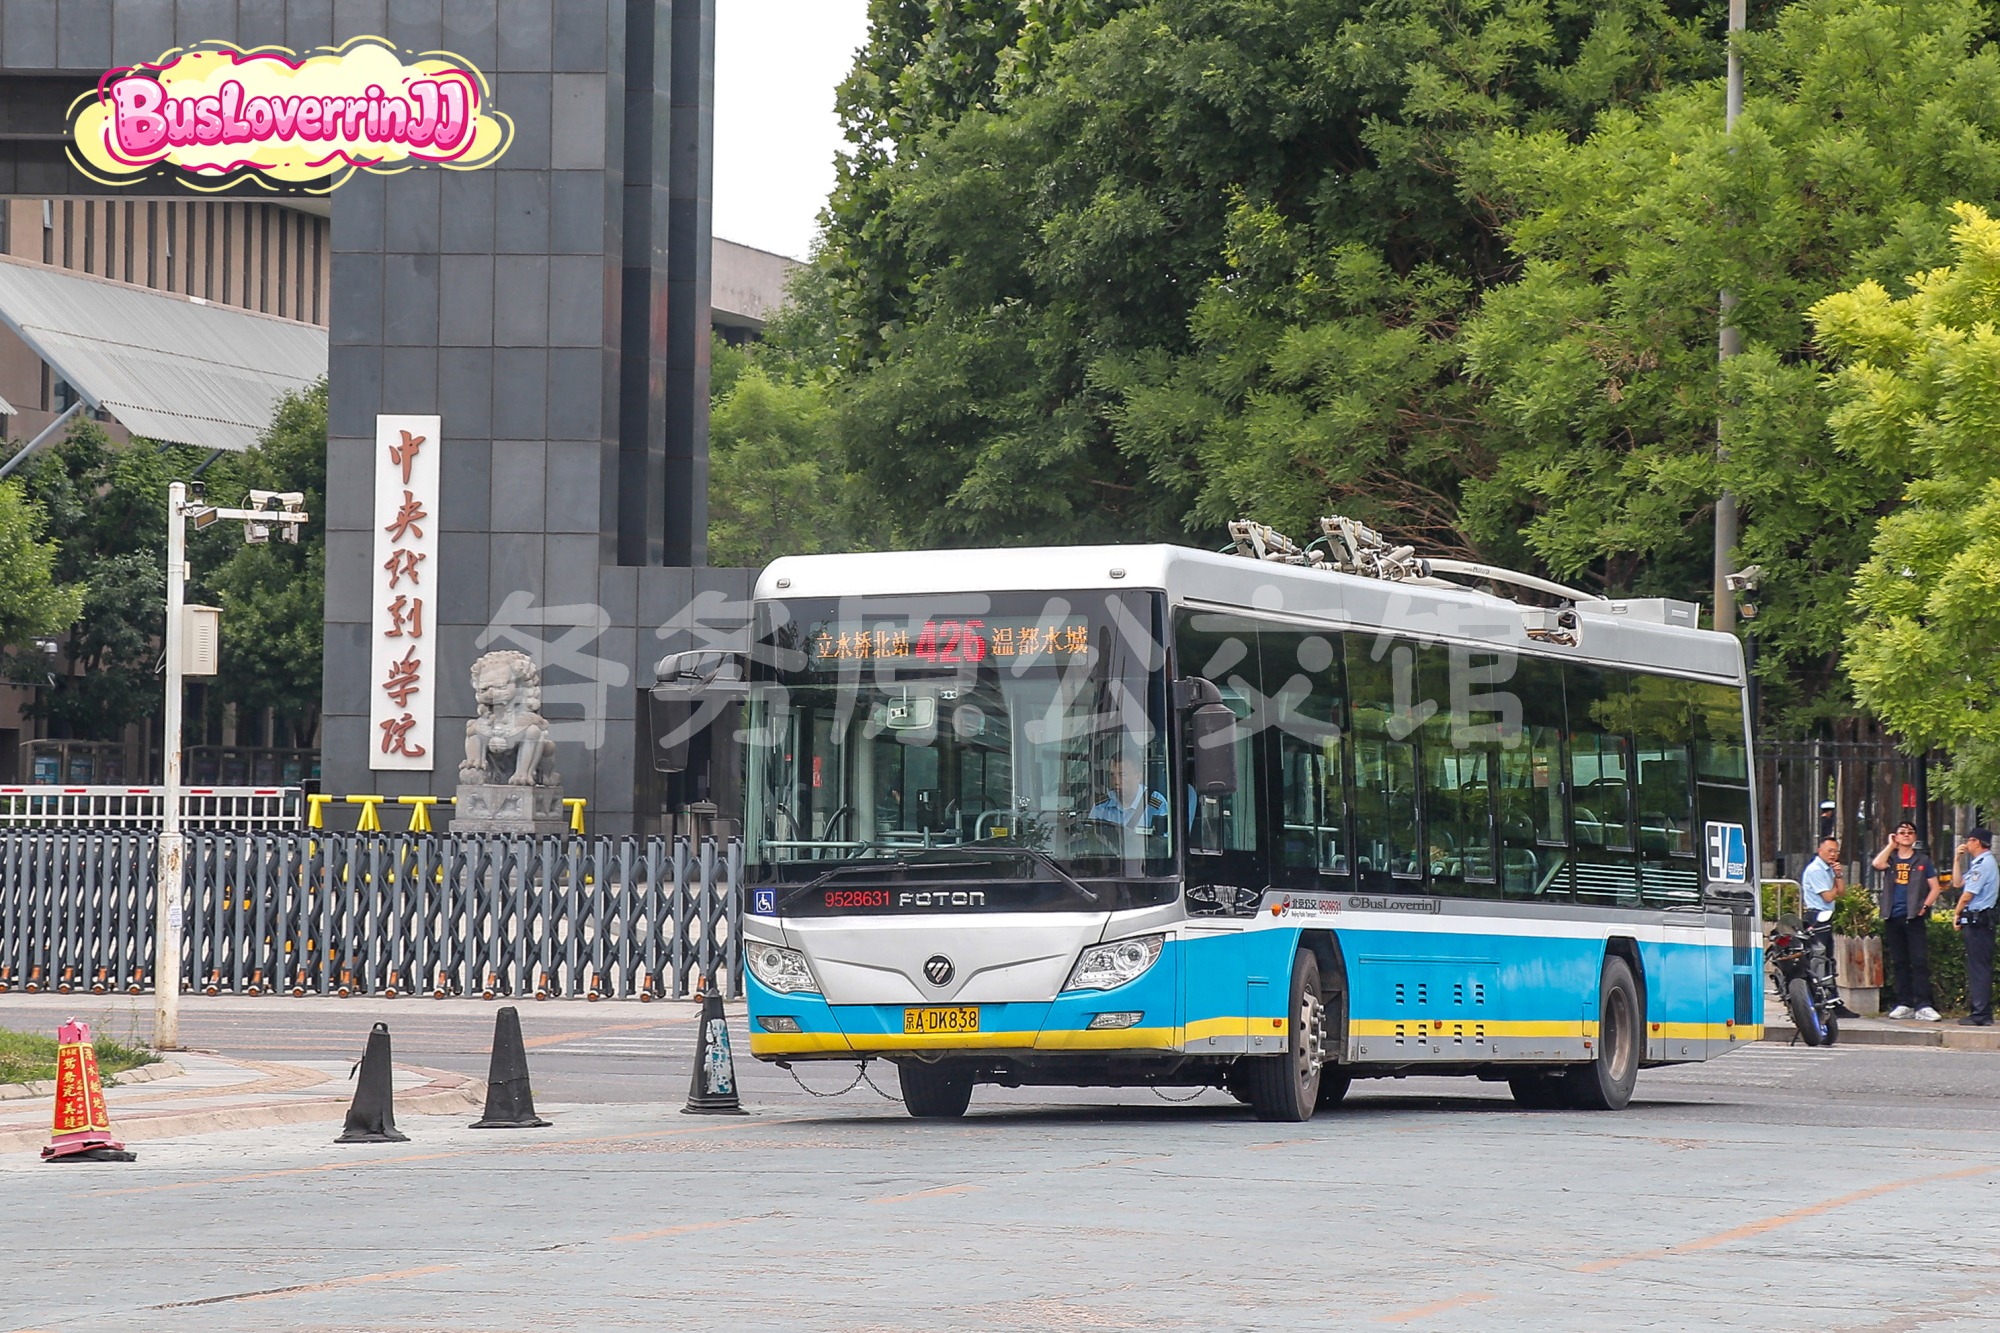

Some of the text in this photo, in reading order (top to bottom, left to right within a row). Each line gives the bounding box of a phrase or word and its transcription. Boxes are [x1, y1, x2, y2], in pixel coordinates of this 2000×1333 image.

[816, 619, 1088, 663] 立水桥北站 426 温都水城
[825, 890, 985, 907] 9528631 FOTON
